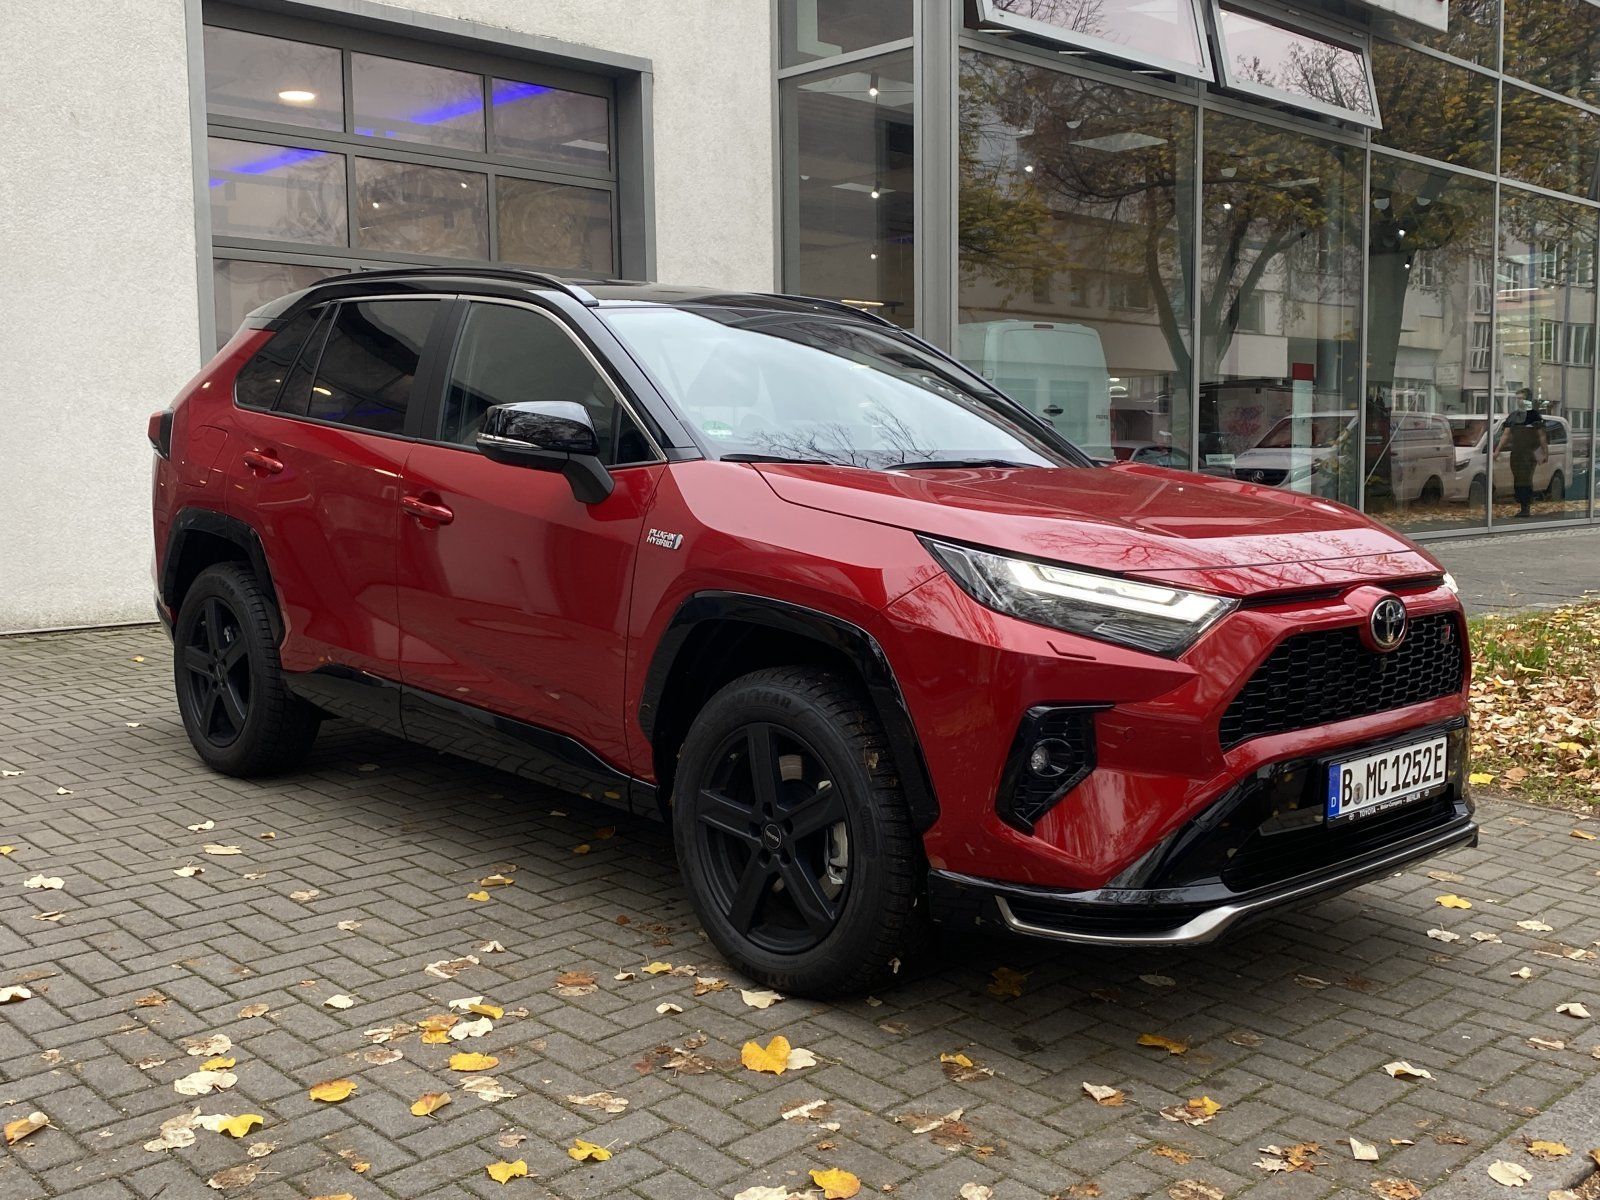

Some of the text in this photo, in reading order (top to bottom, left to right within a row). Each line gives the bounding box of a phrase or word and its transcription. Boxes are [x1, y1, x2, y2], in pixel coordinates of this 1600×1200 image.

[646, 536, 673, 548] HYBRID
[715, 689, 792, 714] OODYEAR
[1342, 768, 1353, 807] B
[1331, 797, 1337, 808] D
[1359, 806, 1376, 818] TOYOTA
